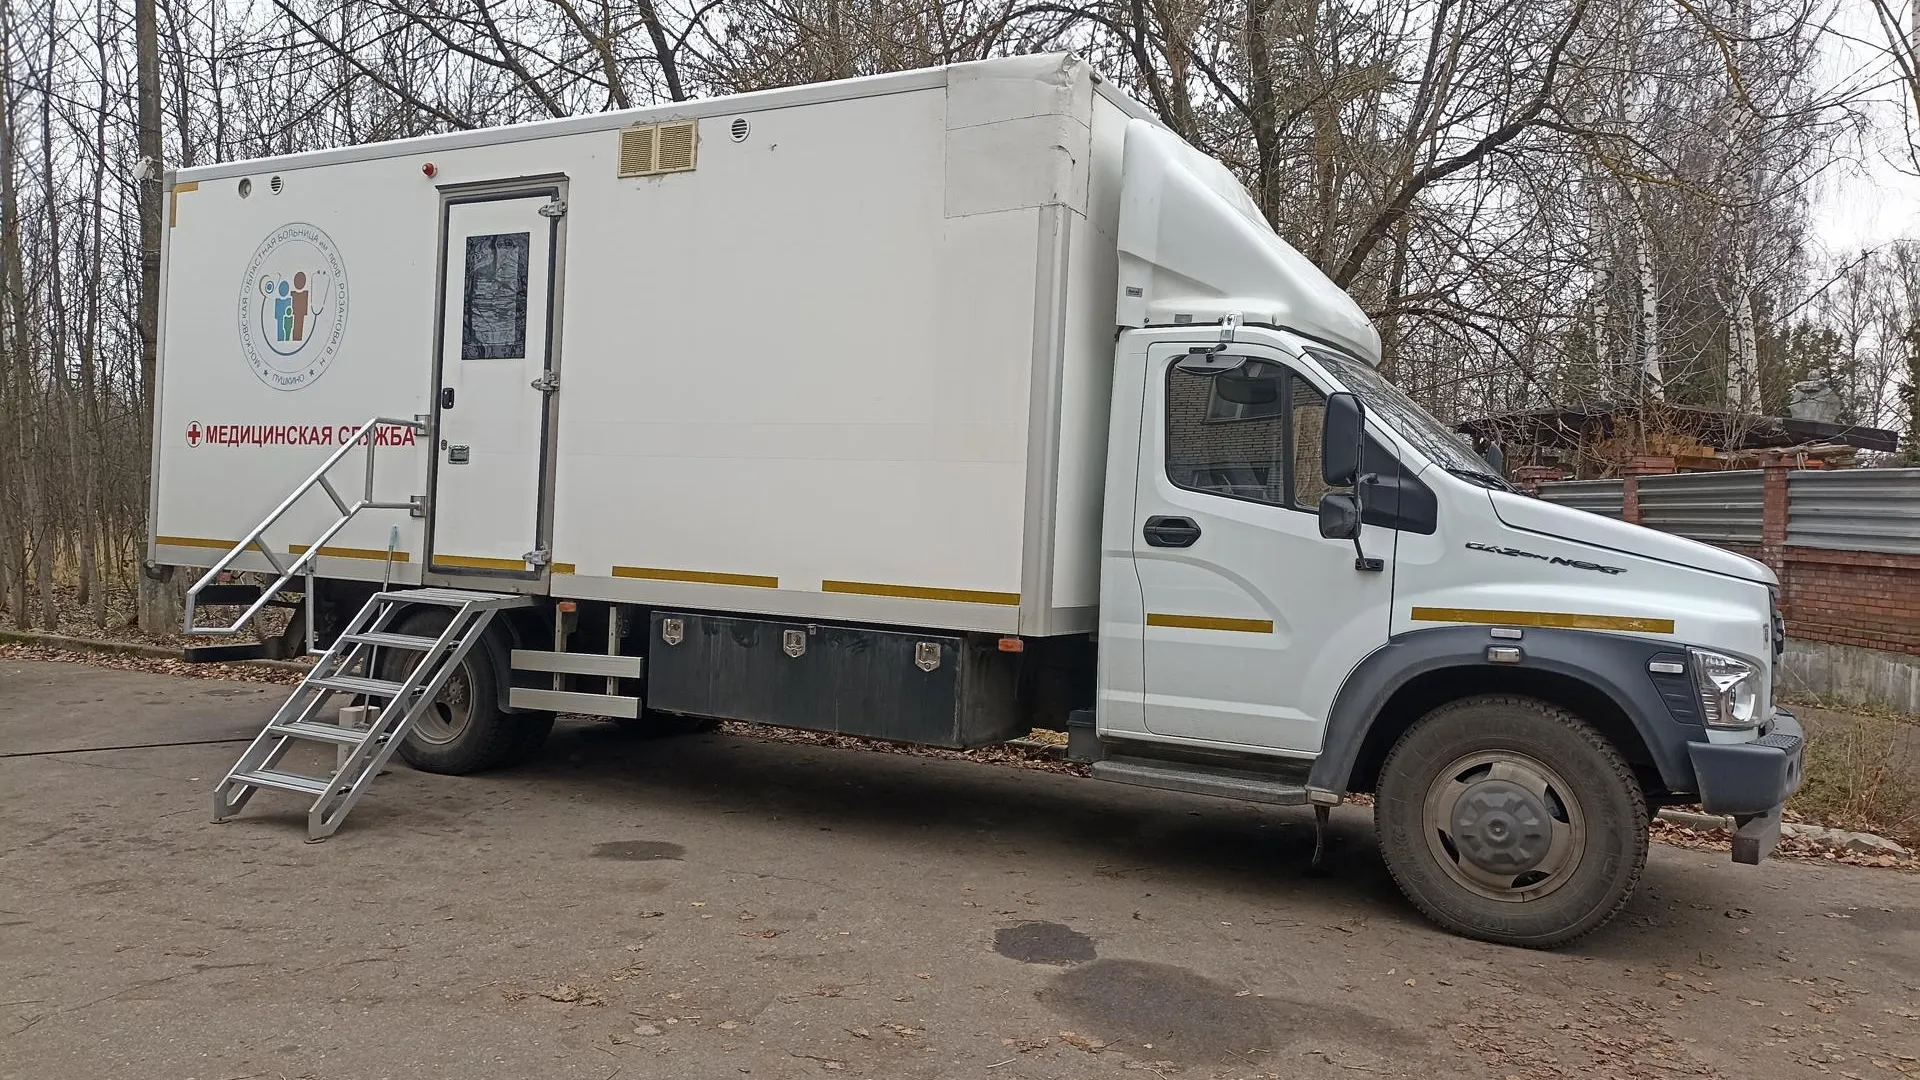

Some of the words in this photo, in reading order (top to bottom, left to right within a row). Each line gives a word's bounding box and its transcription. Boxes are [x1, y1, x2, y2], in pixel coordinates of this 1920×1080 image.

[277, 229, 319, 242] БОЛЬНИЦА
[244, 237, 277, 293] ОБЛАСТНАЯ
[241, 297, 261, 368] МОСКОВСКАЯ
[331, 282, 346, 344] РОЗАНОВА
[272, 373, 305, 386] ПУШКИНО
[205, 425, 333, 447] МЕДИЦИНСКАЯ
